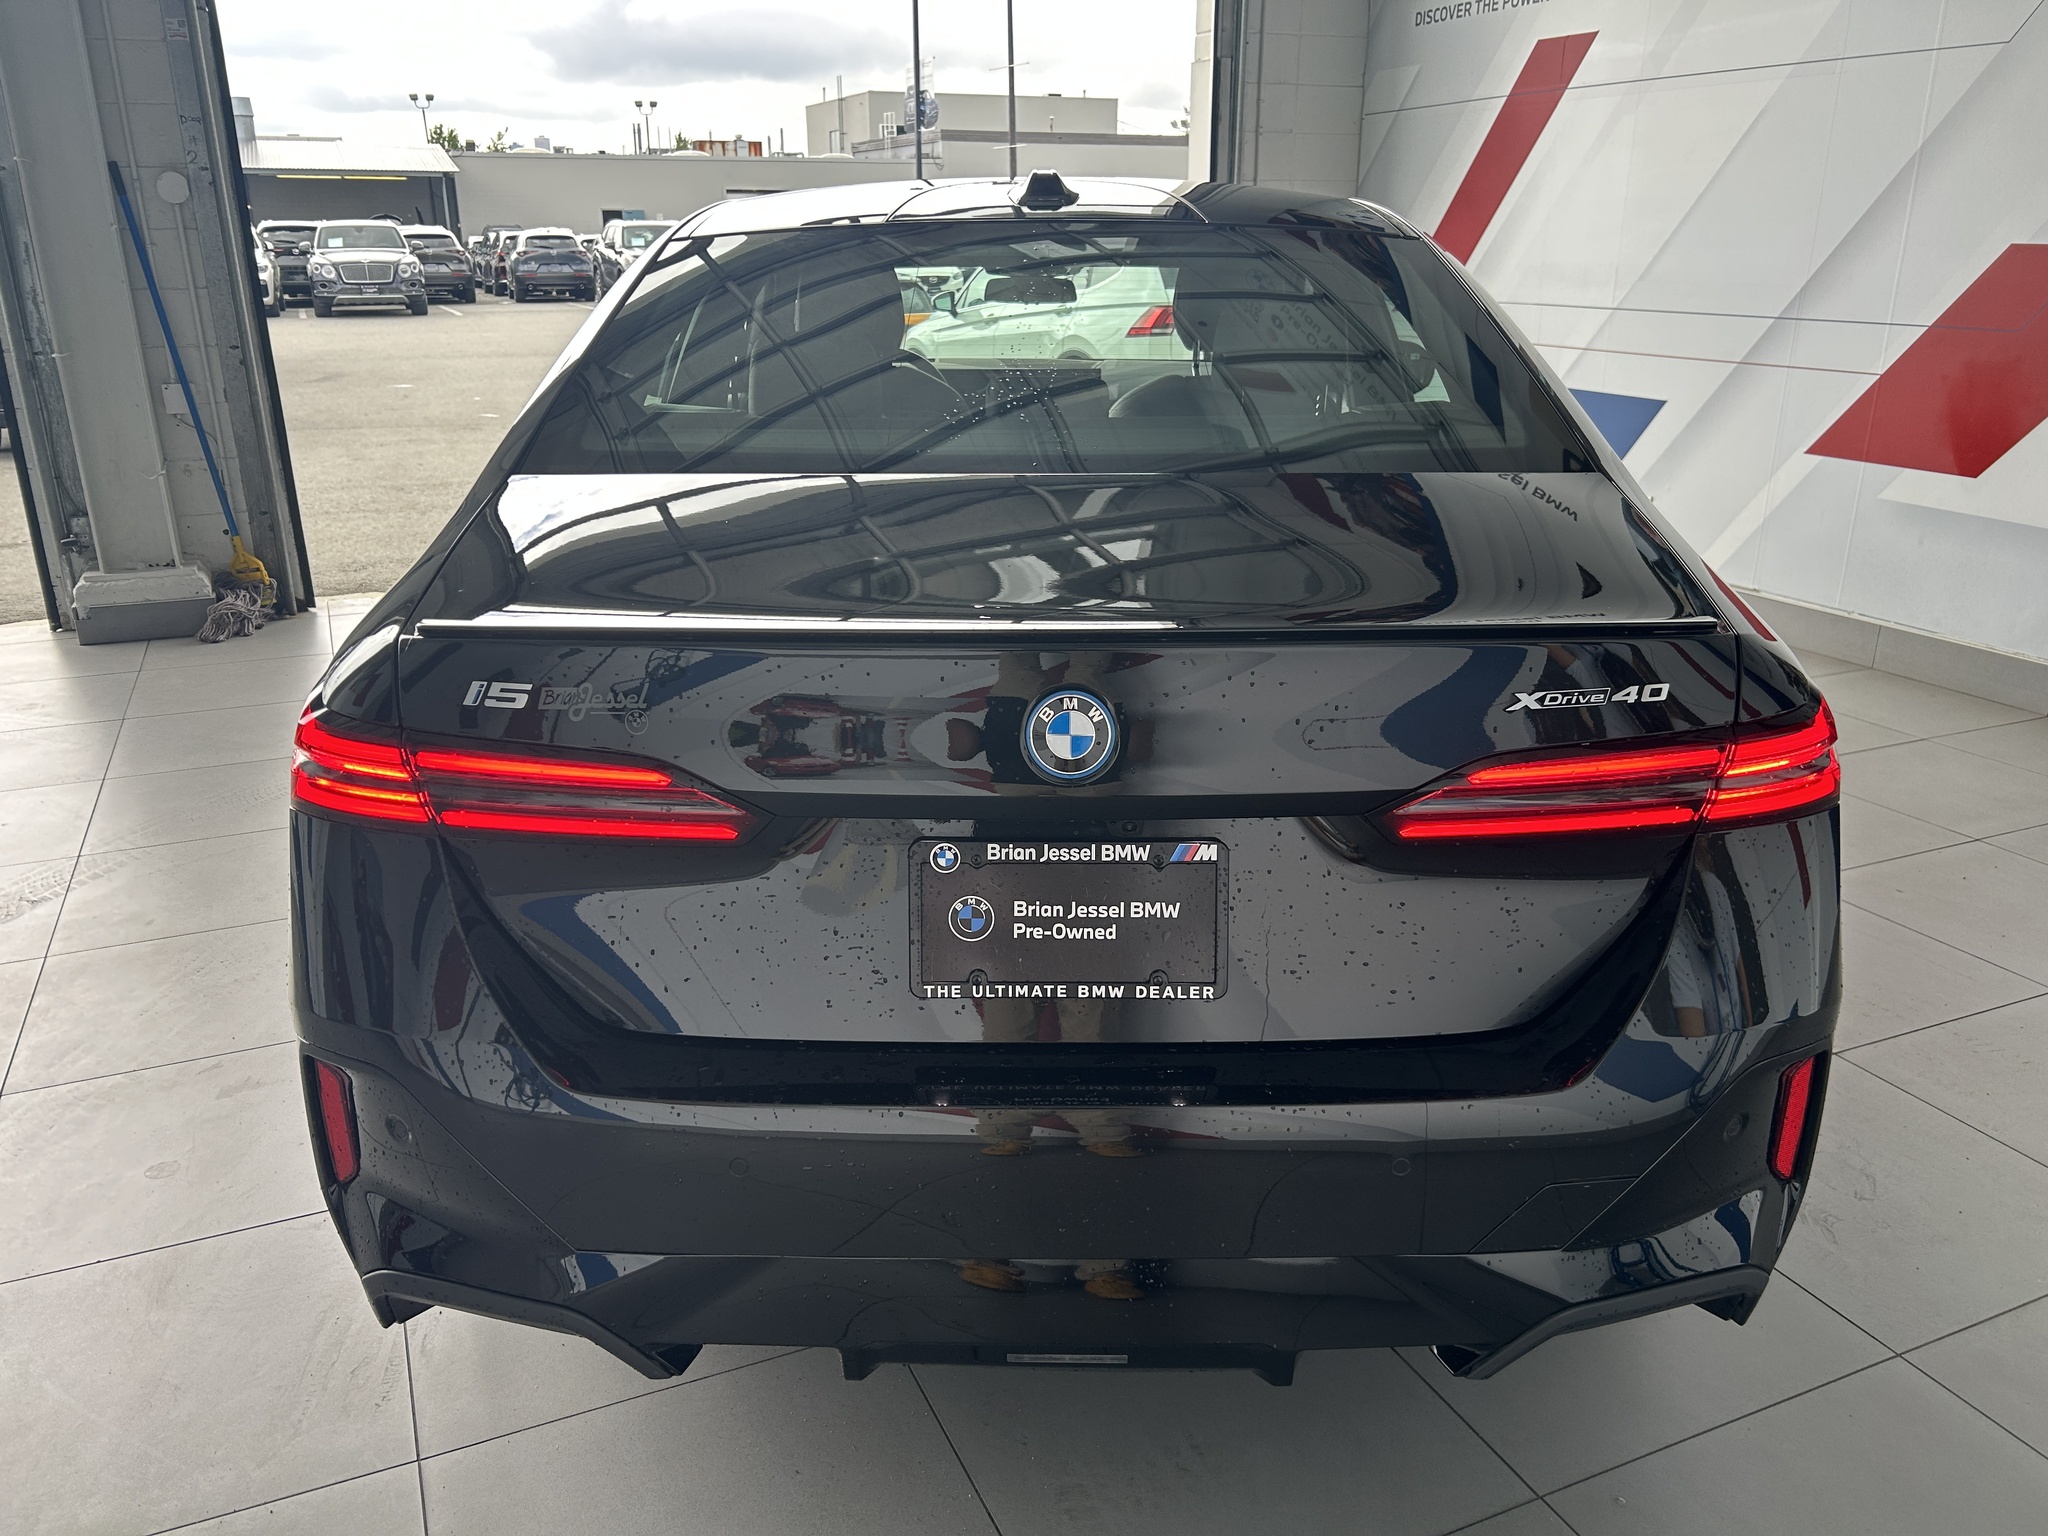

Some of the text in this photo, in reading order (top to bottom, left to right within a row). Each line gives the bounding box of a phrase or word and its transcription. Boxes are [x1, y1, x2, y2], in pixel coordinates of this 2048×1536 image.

[1415, 1, 1472, 27] DISCOVER
[1475, 0, 1499, 15] THE
[568, 682, 649, 722] Jessel
[1038, 697, 1104, 723] BMW
[986, 843, 1151, 863] Brian Jessel BMW
[1013, 900, 1181, 920] Brian Jessel BMW
[1013, 923, 1117, 940] Pre-Owned
[923, 985, 1215, 999] THE ULTIMATE BMW DEALER
